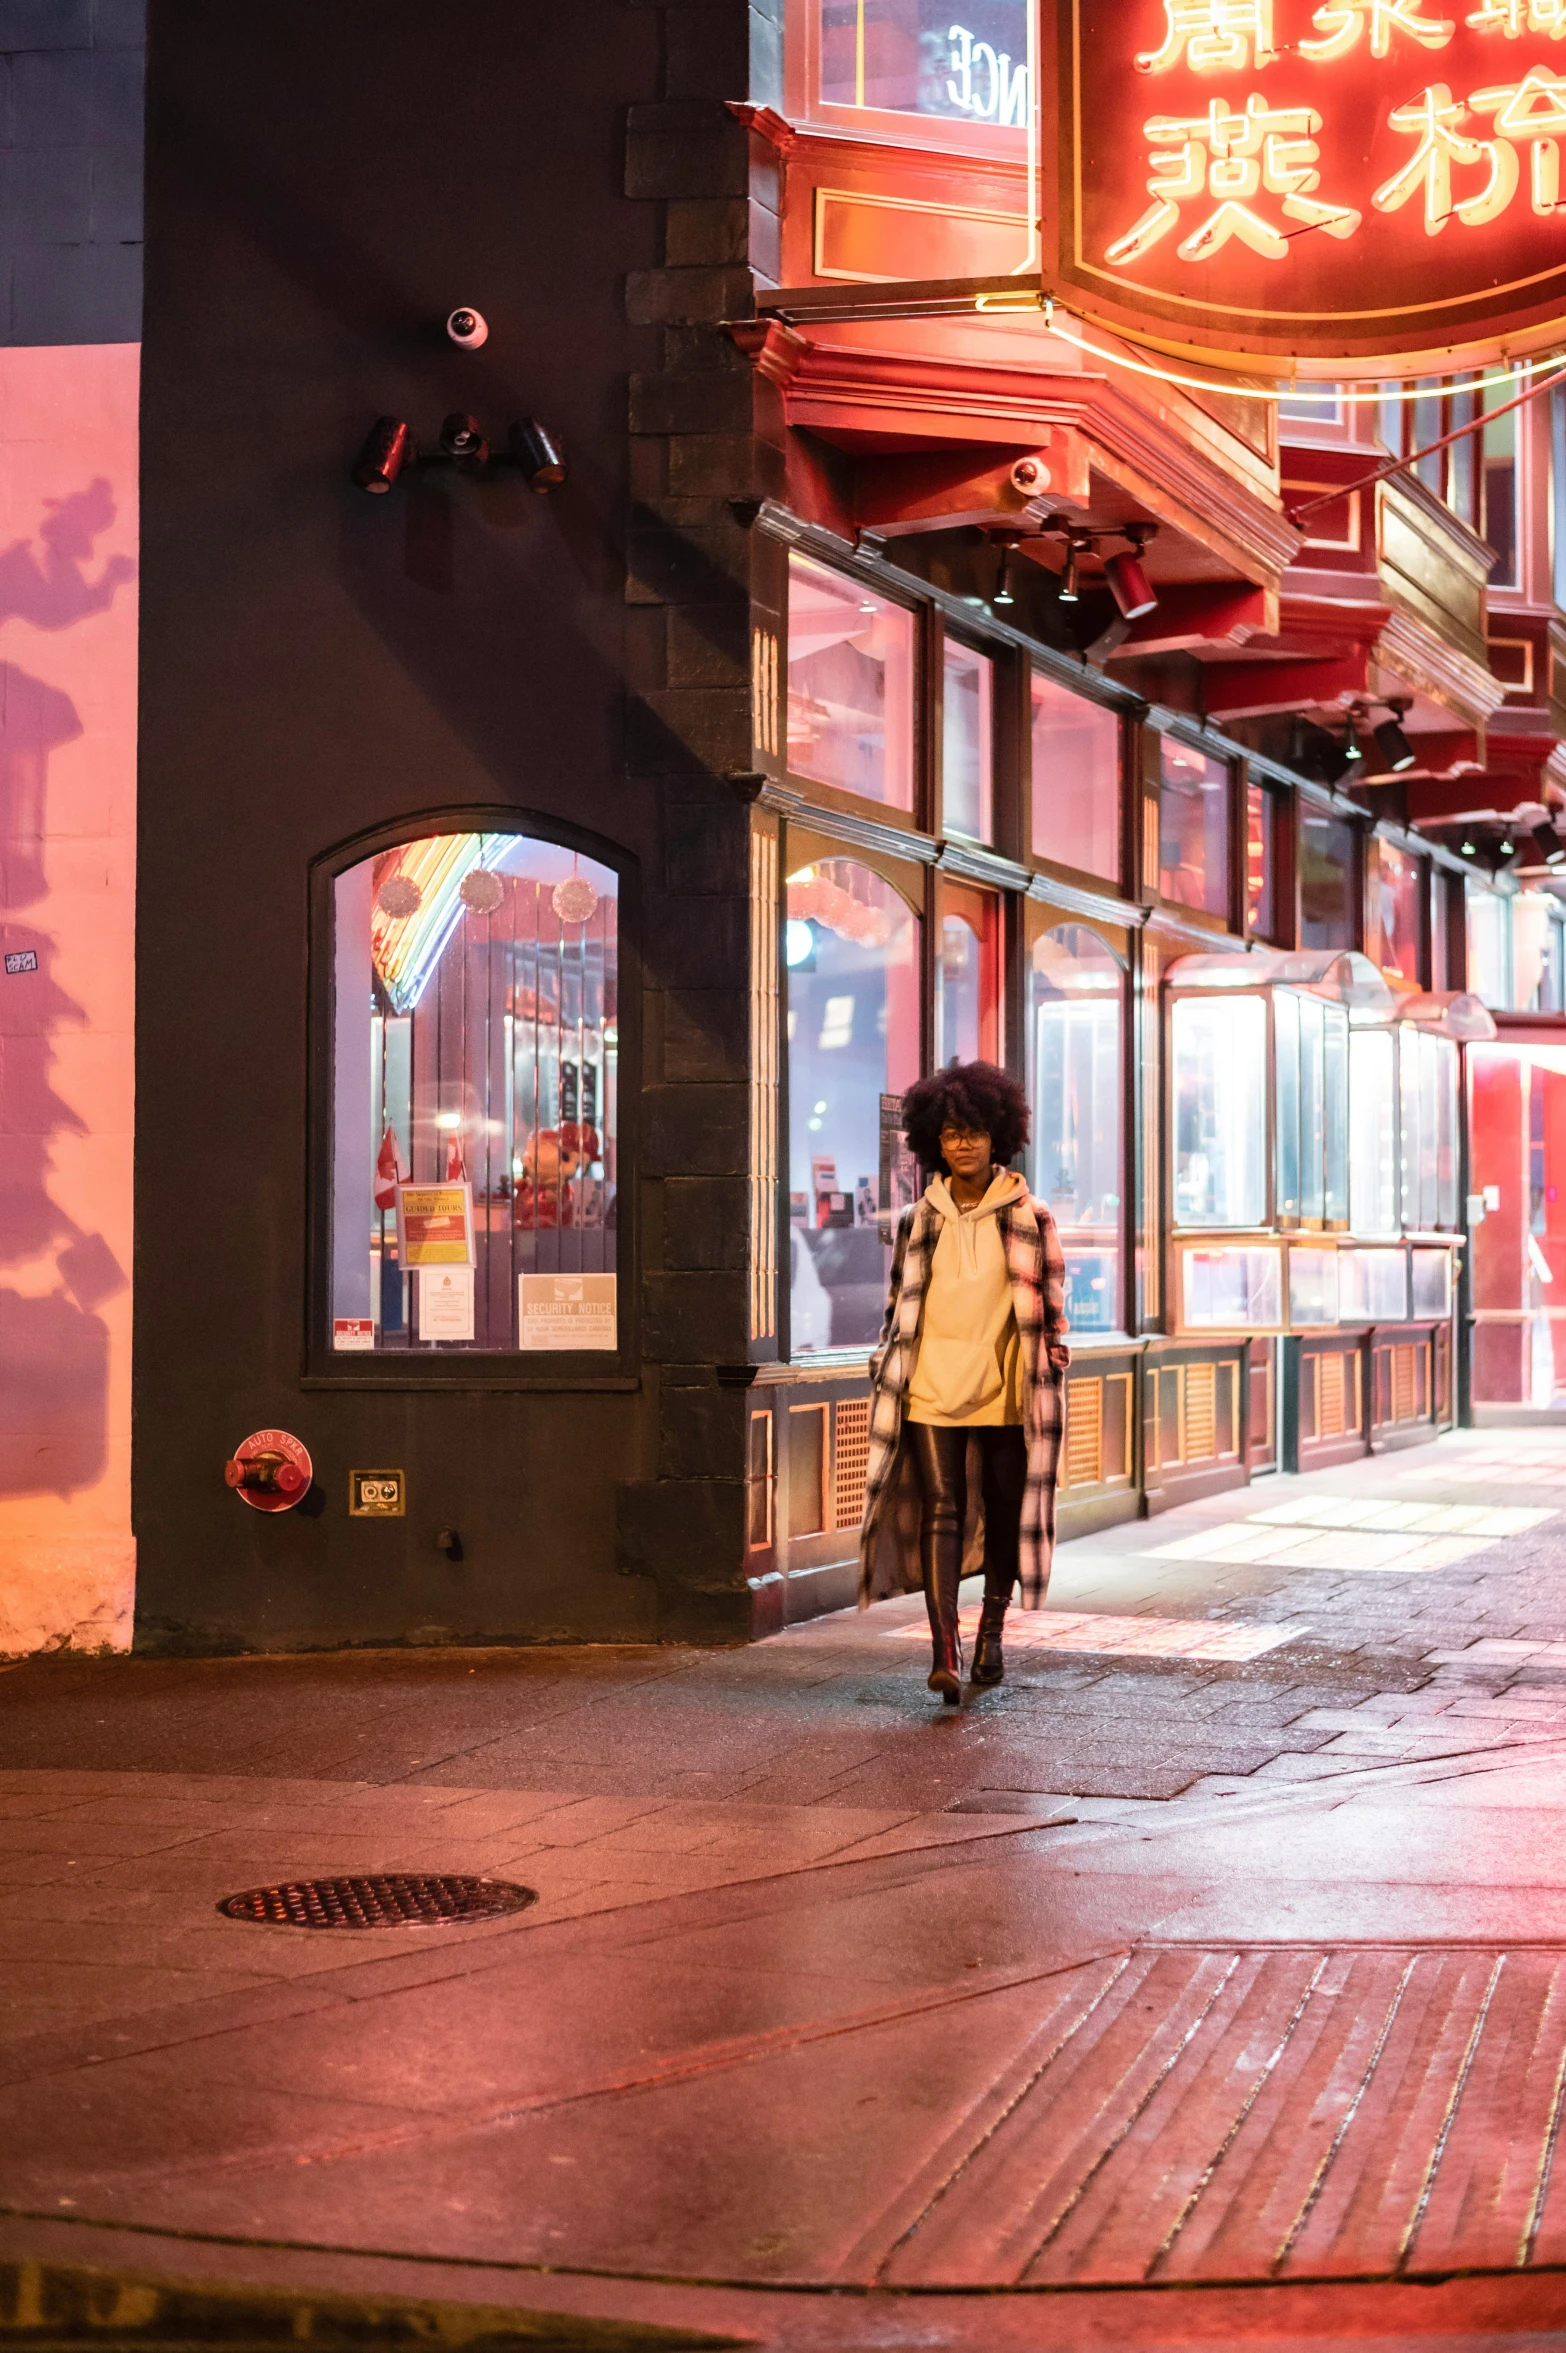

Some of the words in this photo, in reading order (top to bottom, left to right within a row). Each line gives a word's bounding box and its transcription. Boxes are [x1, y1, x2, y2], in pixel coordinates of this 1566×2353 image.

[9, 958, 33, 971] SCAM
[527, 1302, 573, 1314] SECURITY
[578, 1302, 612, 1314] NOTICE
[248, 1432, 274, 1450] AUTO
[280, 1434, 303, 1456] SPKR
